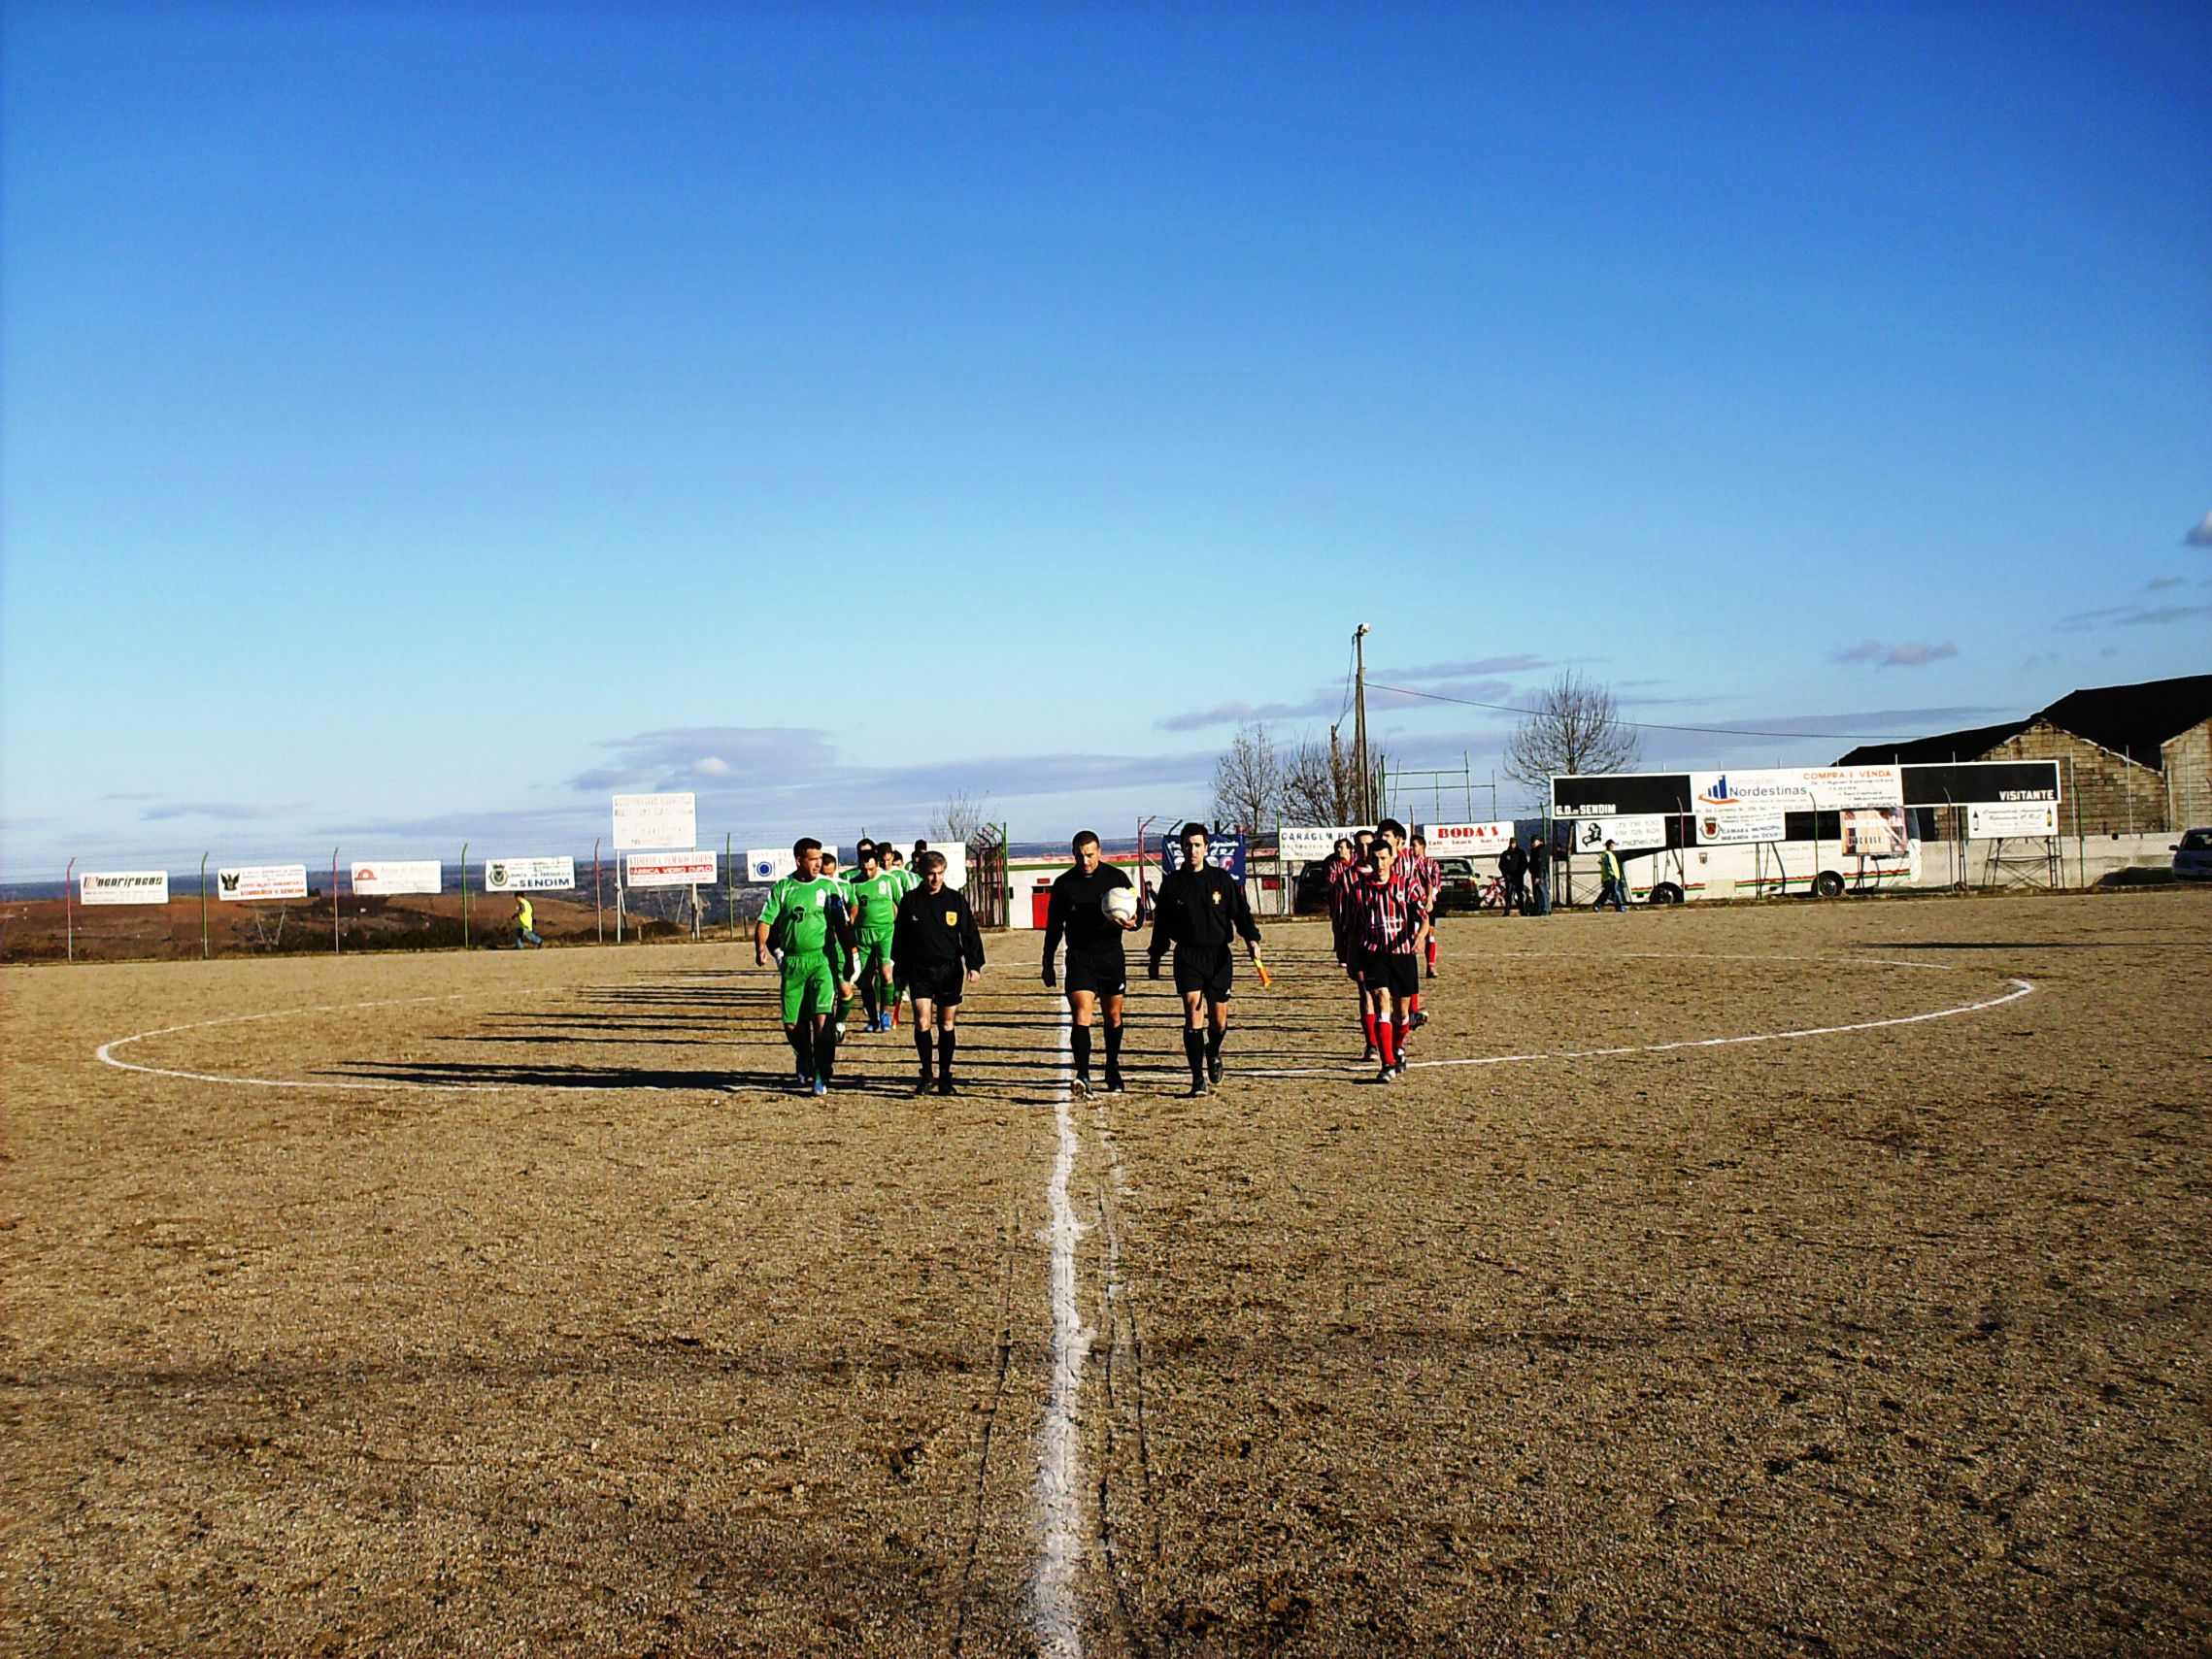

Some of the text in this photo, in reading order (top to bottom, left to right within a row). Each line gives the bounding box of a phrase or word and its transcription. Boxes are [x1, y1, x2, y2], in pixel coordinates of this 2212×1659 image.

[1803, 771, 1845, 780] COMPRA
[1860, 769, 1893, 779] VENDA
[1729, 784, 1807, 798] Nordestinas
[1998, 790, 2055, 801] VISITANTE
[1580, 804, 1617, 815] SENDIM
[1438, 826, 1499, 839] BODA'S
[519, 878, 570, 888] SENDIM
